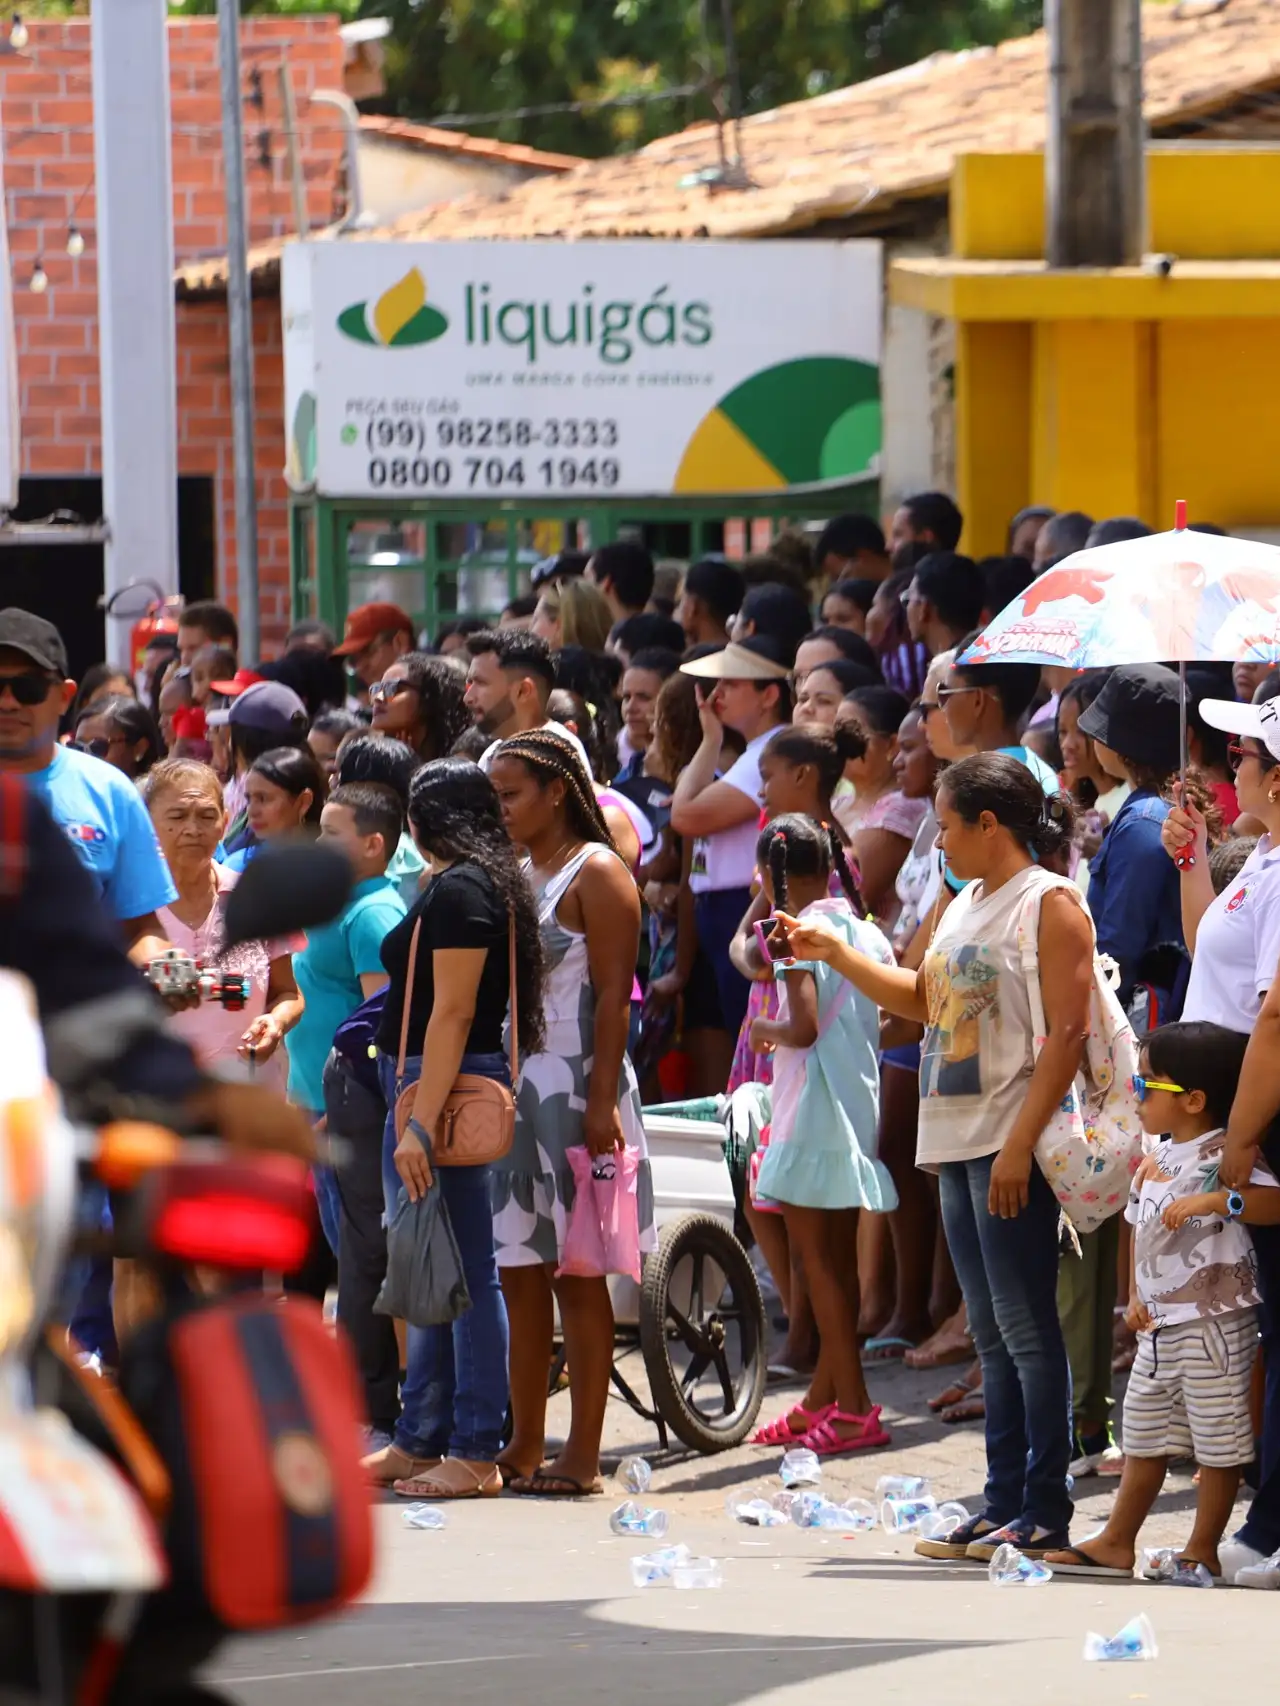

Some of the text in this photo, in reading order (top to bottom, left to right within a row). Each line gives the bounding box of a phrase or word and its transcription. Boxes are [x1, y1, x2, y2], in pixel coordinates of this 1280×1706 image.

[464, 282, 713, 366] liquigás
[365, 418, 619, 453] (99) 98258-3333
[368, 457, 621, 488] 0800 704 1949
